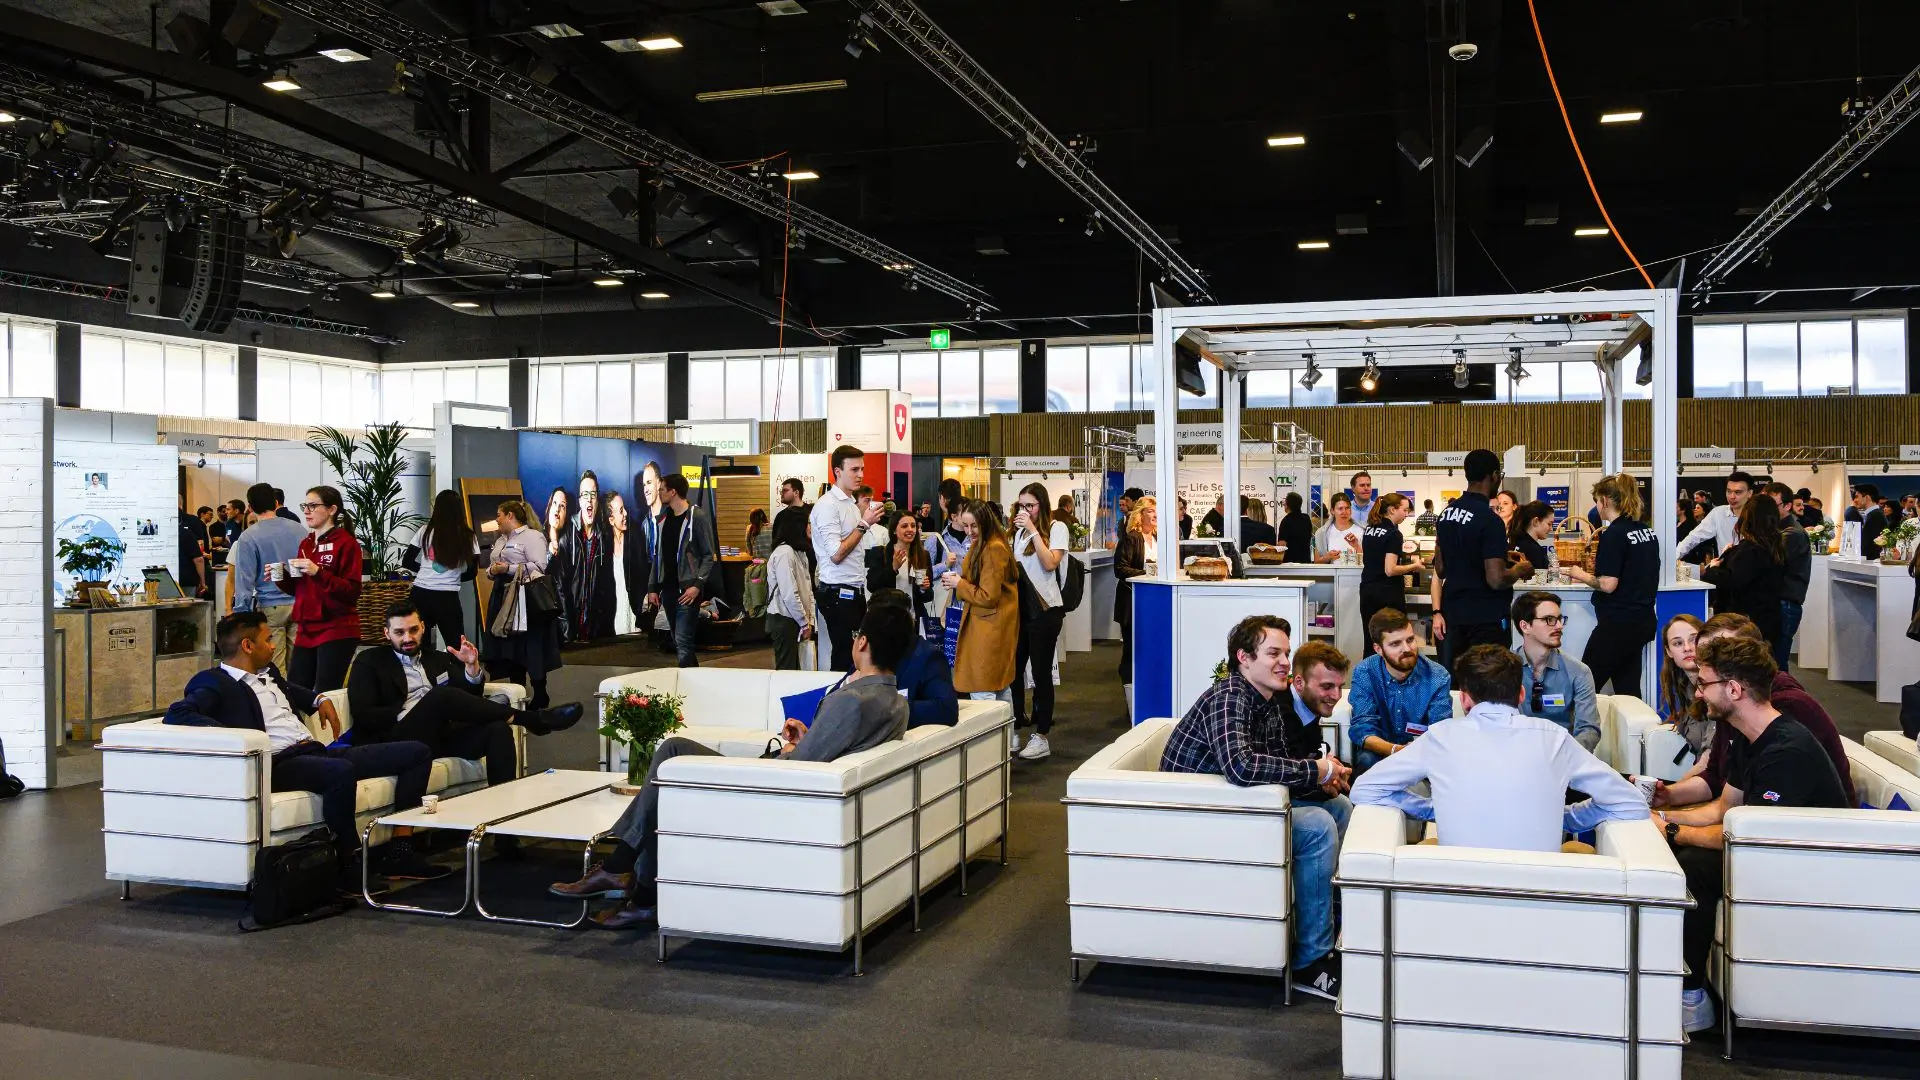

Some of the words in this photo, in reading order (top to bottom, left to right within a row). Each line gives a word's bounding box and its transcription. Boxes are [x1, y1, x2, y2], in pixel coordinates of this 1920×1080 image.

[1177, 429, 1222, 439] ngineering
[690, 440, 744, 449] YNTEGON
[1190, 483, 1209, 492] Life
[1211, 483, 1256, 492] Scces
[1440, 507, 1474, 525] STAFF
[1365, 527, 1387, 537] TAFF
[1627, 528, 1656, 545] STAFF
